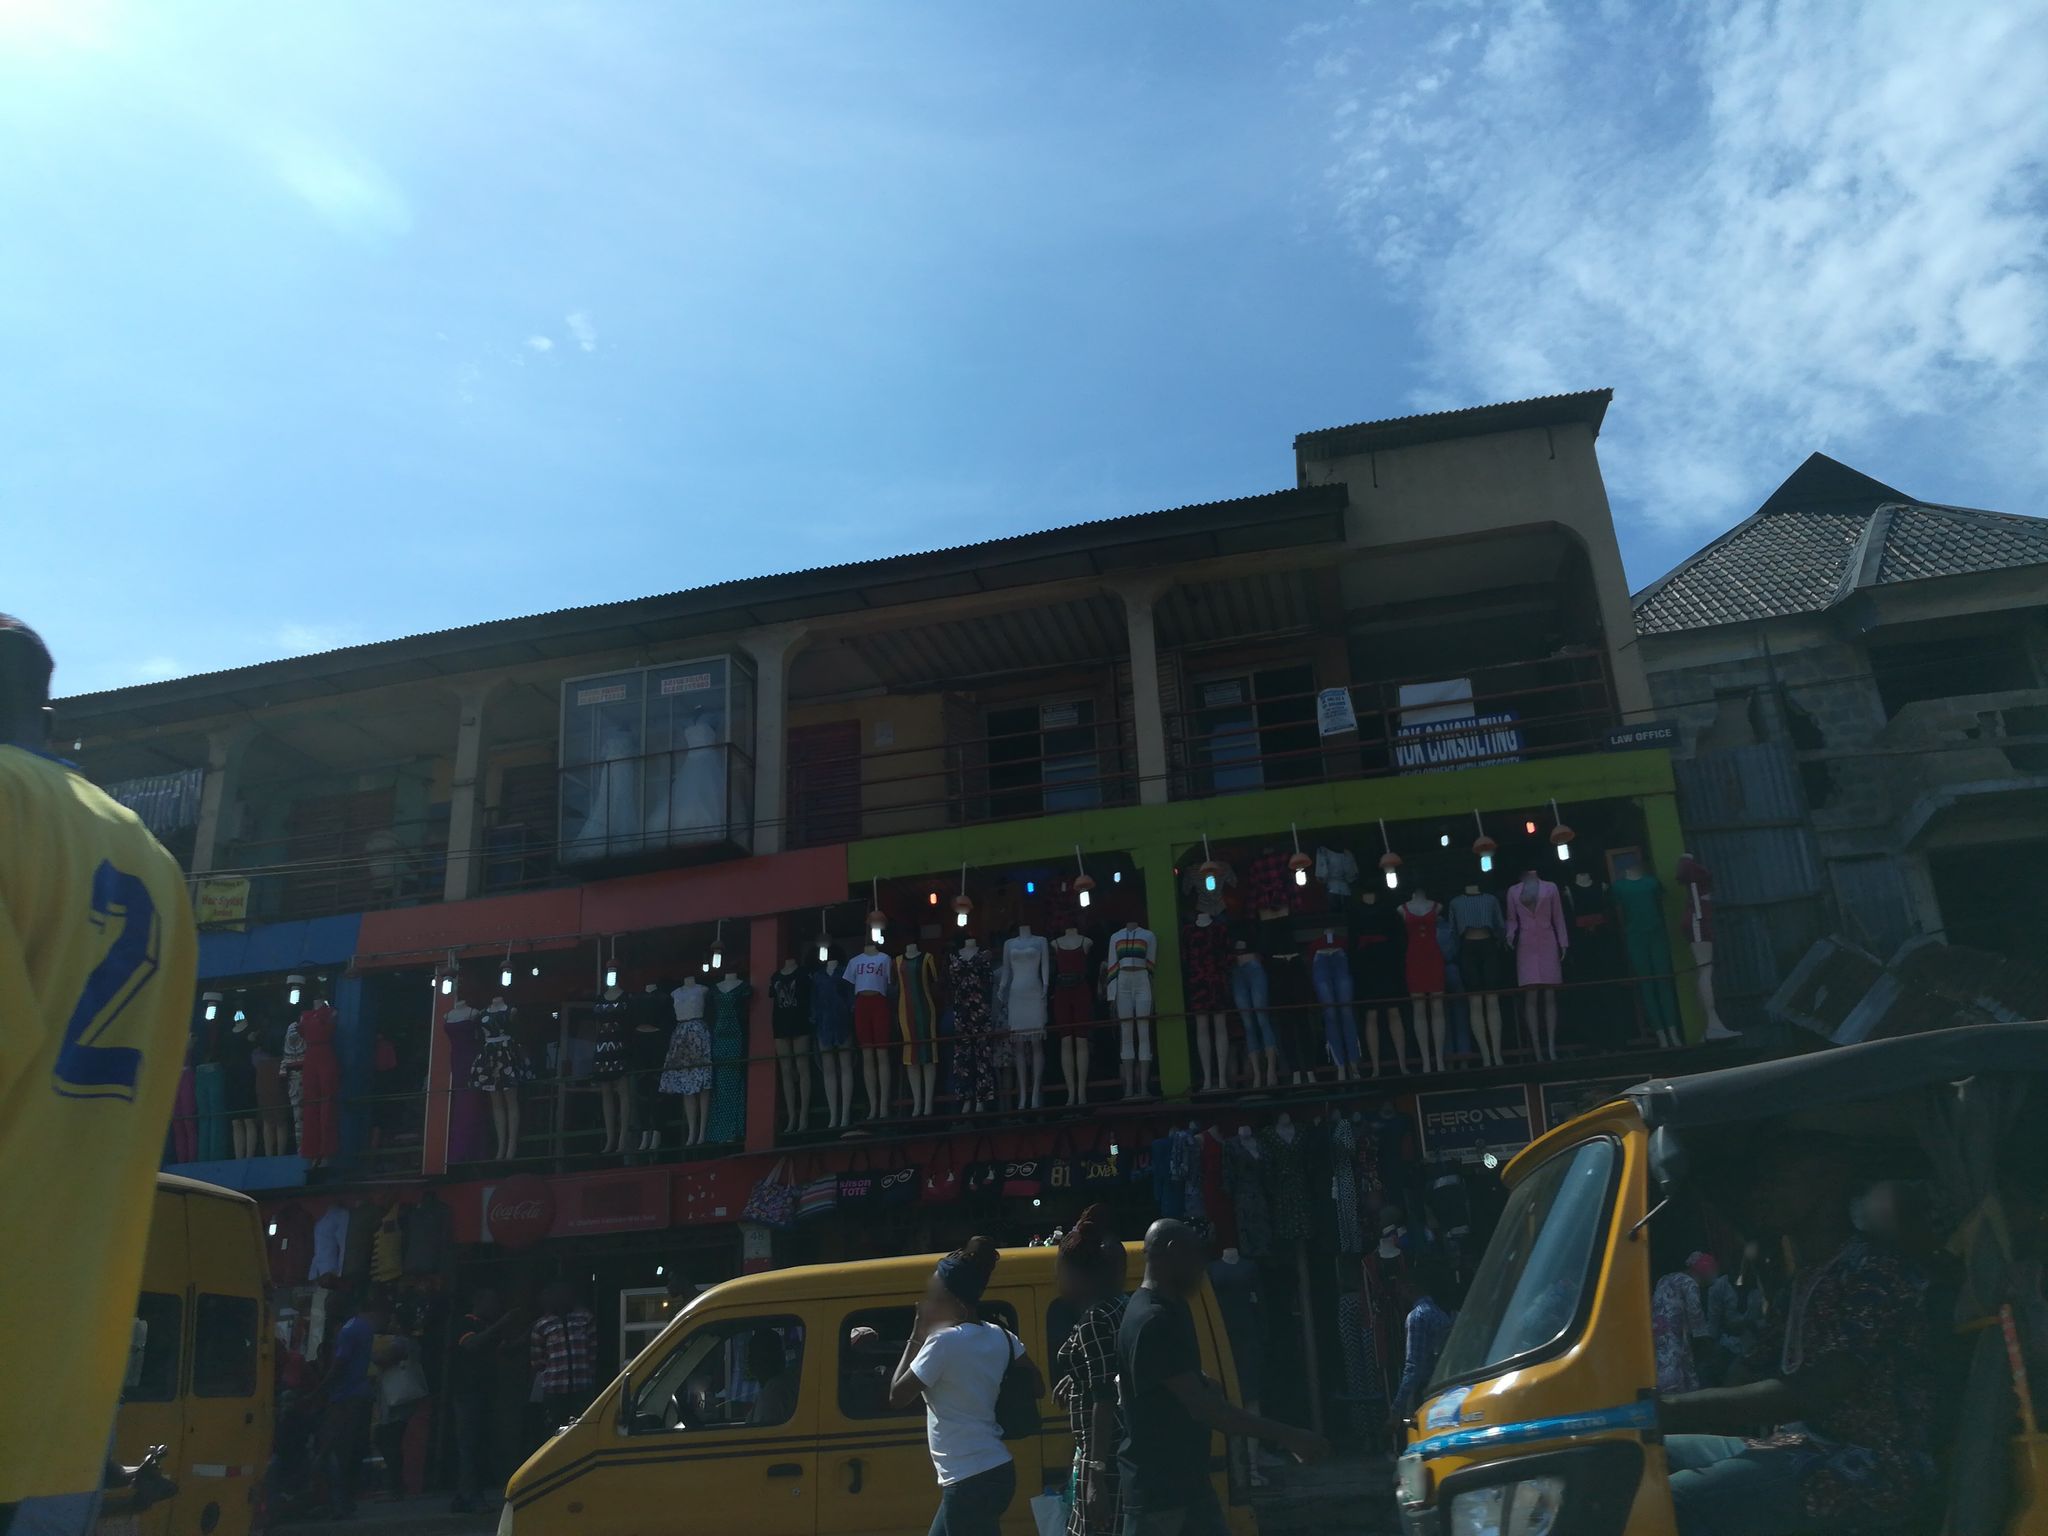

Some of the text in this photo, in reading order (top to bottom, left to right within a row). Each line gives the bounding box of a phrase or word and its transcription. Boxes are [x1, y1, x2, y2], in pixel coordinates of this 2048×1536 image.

[1426, 714, 1518, 762] CONSULTING
[1611, 728, 1673, 745] LAW OFFICE
[857, 962, 883, 976] USA
[53, 858, 160, 1103] 2
[1426, 1108, 1483, 1128] FERO
[1428, 1125, 1485, 1136] MOBILE
[1050, 1166, 1071, 1187] 81
[842, 1187, 867, 1197] TOTE
